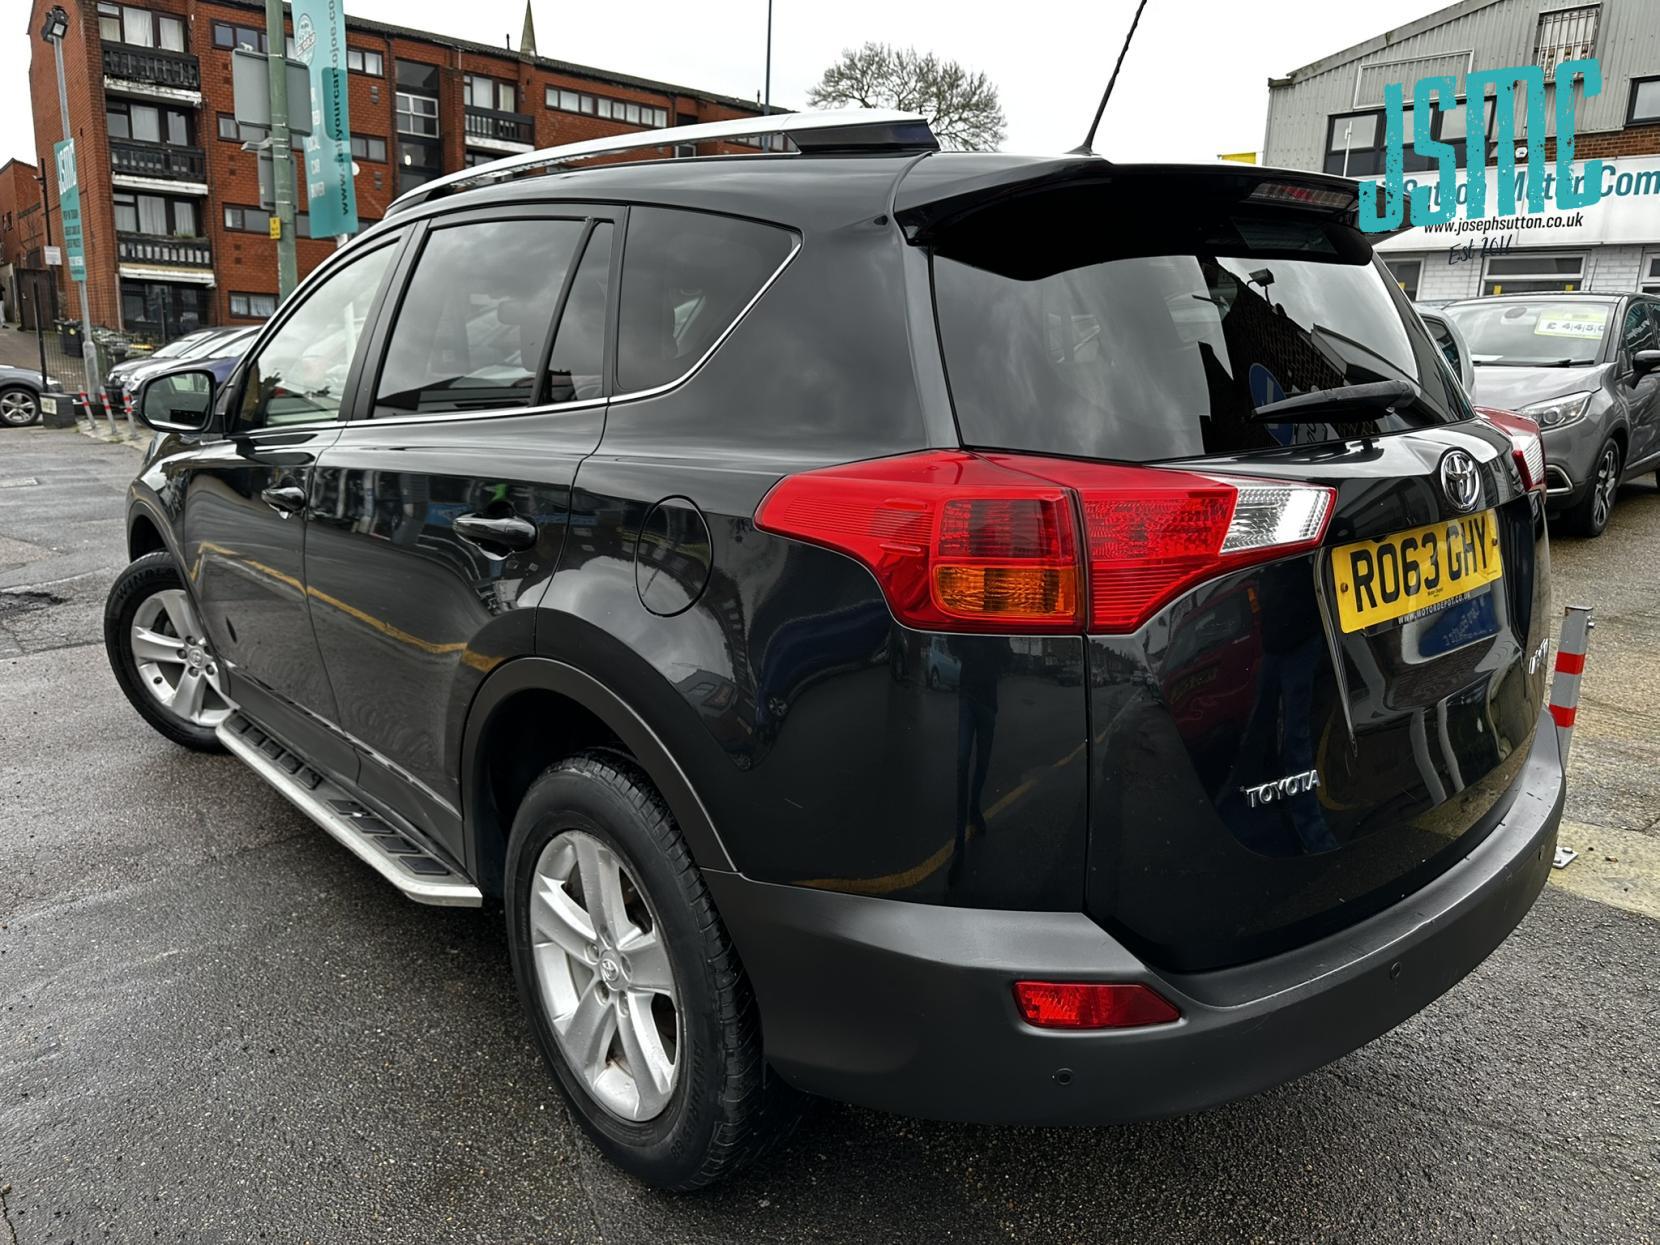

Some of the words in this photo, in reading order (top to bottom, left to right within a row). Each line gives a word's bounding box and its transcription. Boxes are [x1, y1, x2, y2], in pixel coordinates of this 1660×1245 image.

[1424, 211, 1584, 236] www.josephsutton.co.uk
[1350, 531, 1441, 613] RO63
[1445, 516, 1488, 582] GHY
[1246, 769, 1321, 808] TOYOTA
